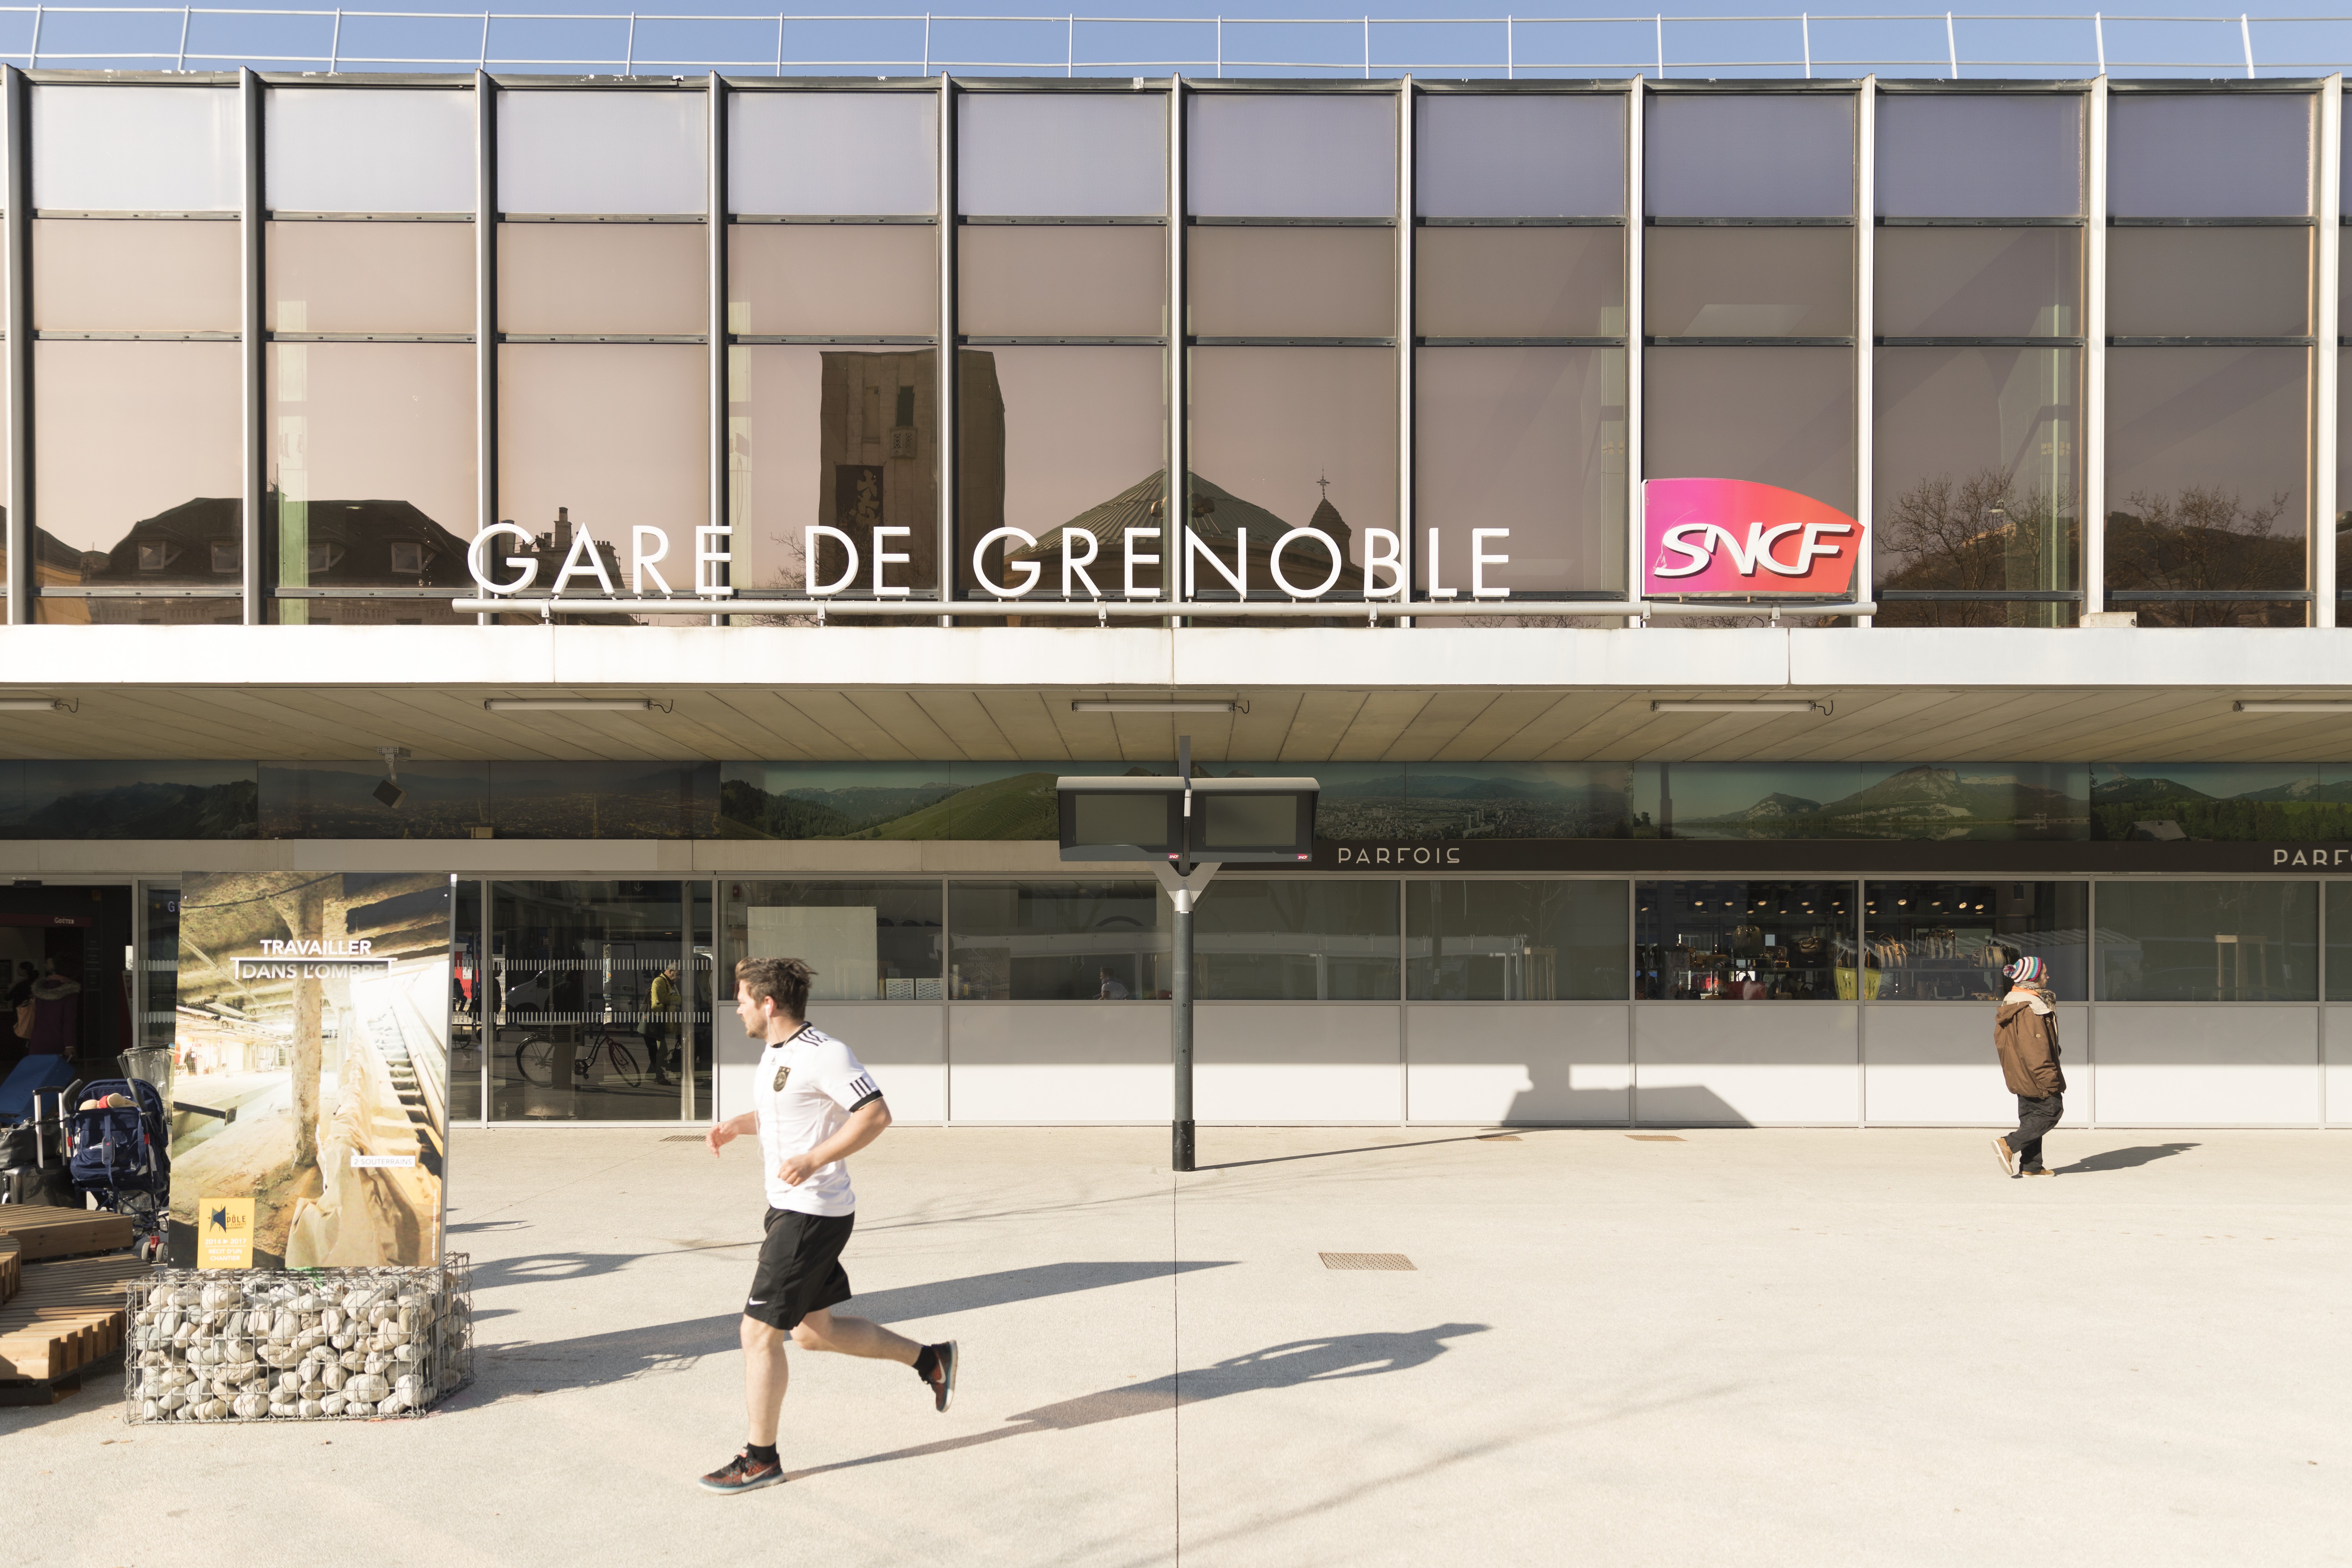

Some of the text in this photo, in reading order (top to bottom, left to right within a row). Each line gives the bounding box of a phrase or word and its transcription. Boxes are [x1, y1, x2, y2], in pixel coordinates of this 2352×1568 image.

[1654, 522, 1852, 576] SNCF
[468, 522, 1510, 599] GARE DE GRENOBLE
[1338, 847, 1460, 863] PARFOIS
[2274, 849, 2352, 865] PARF
[260, 940, 372, 955] TRAVAILLER
[242, 964, 297, 979] DANS
[227, 1215, 246, 1223] PÔLE
